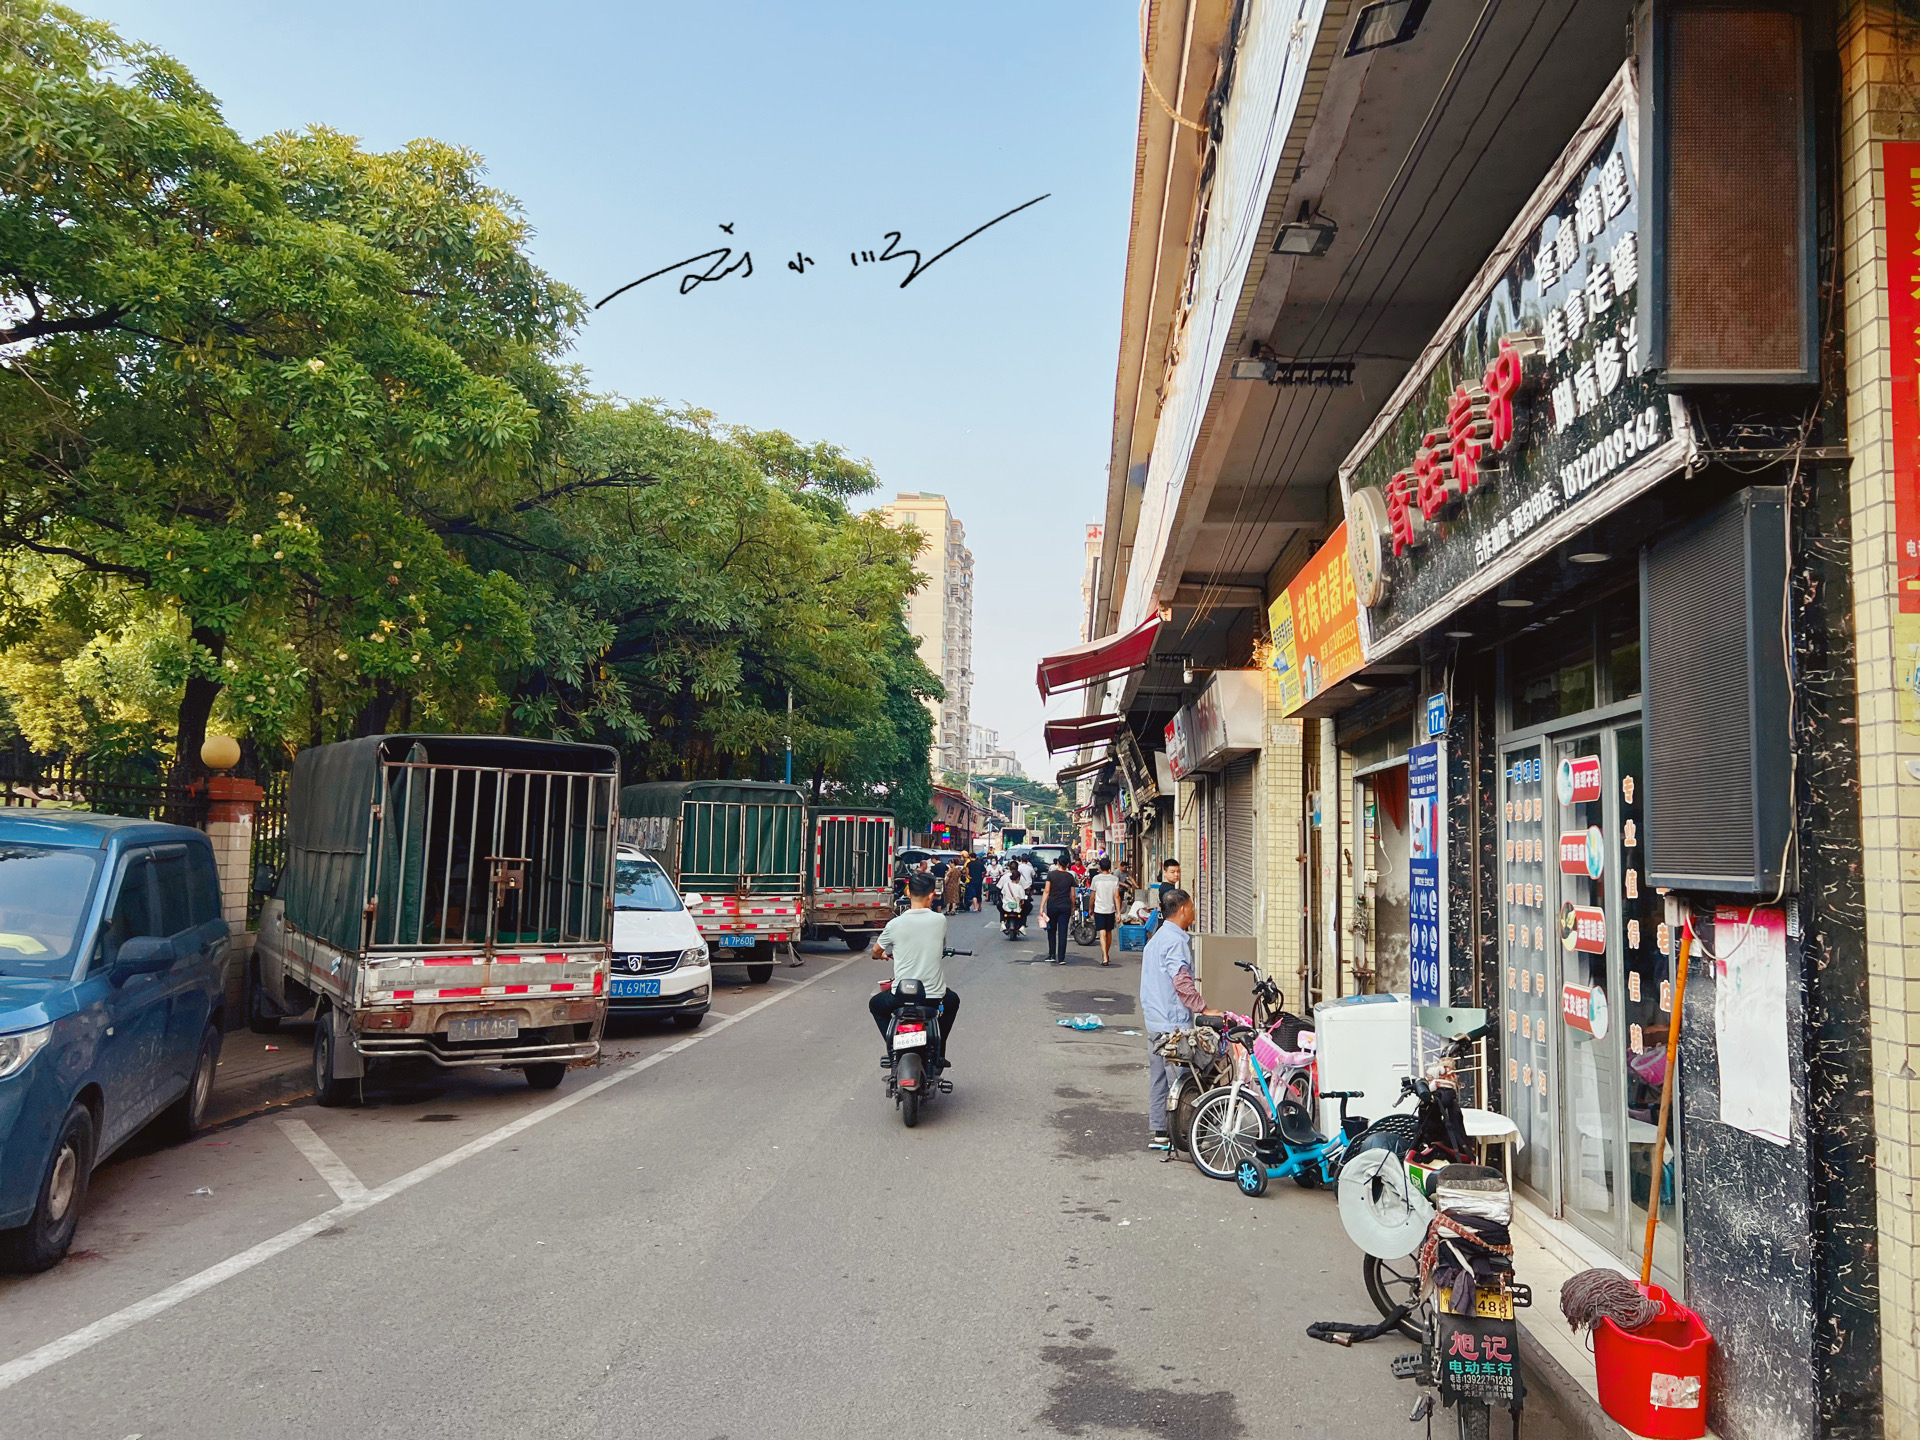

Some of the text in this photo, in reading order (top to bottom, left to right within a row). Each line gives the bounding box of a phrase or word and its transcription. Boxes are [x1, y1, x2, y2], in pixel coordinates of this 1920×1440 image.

[1533, 152, 1630, 298] 疼痛调理
[1541, 231, 1638, 365] 推拿走罐
[1559, 405, 1660, 501] 18122289562
[1905, 538, 1920, 558] 电
[1297, 542, 1357, 644] 老陈电器店
[1506, 757, 1541, 785] 一楼项目
[1506, 797, 1542, 823] 专业修脚
[1622, 774, 1644, 1056] 专业值得信赖
[1449, 1330, 1512, 1362] 旭记
[1449, 1360, 1513, 1377] 电动车行
